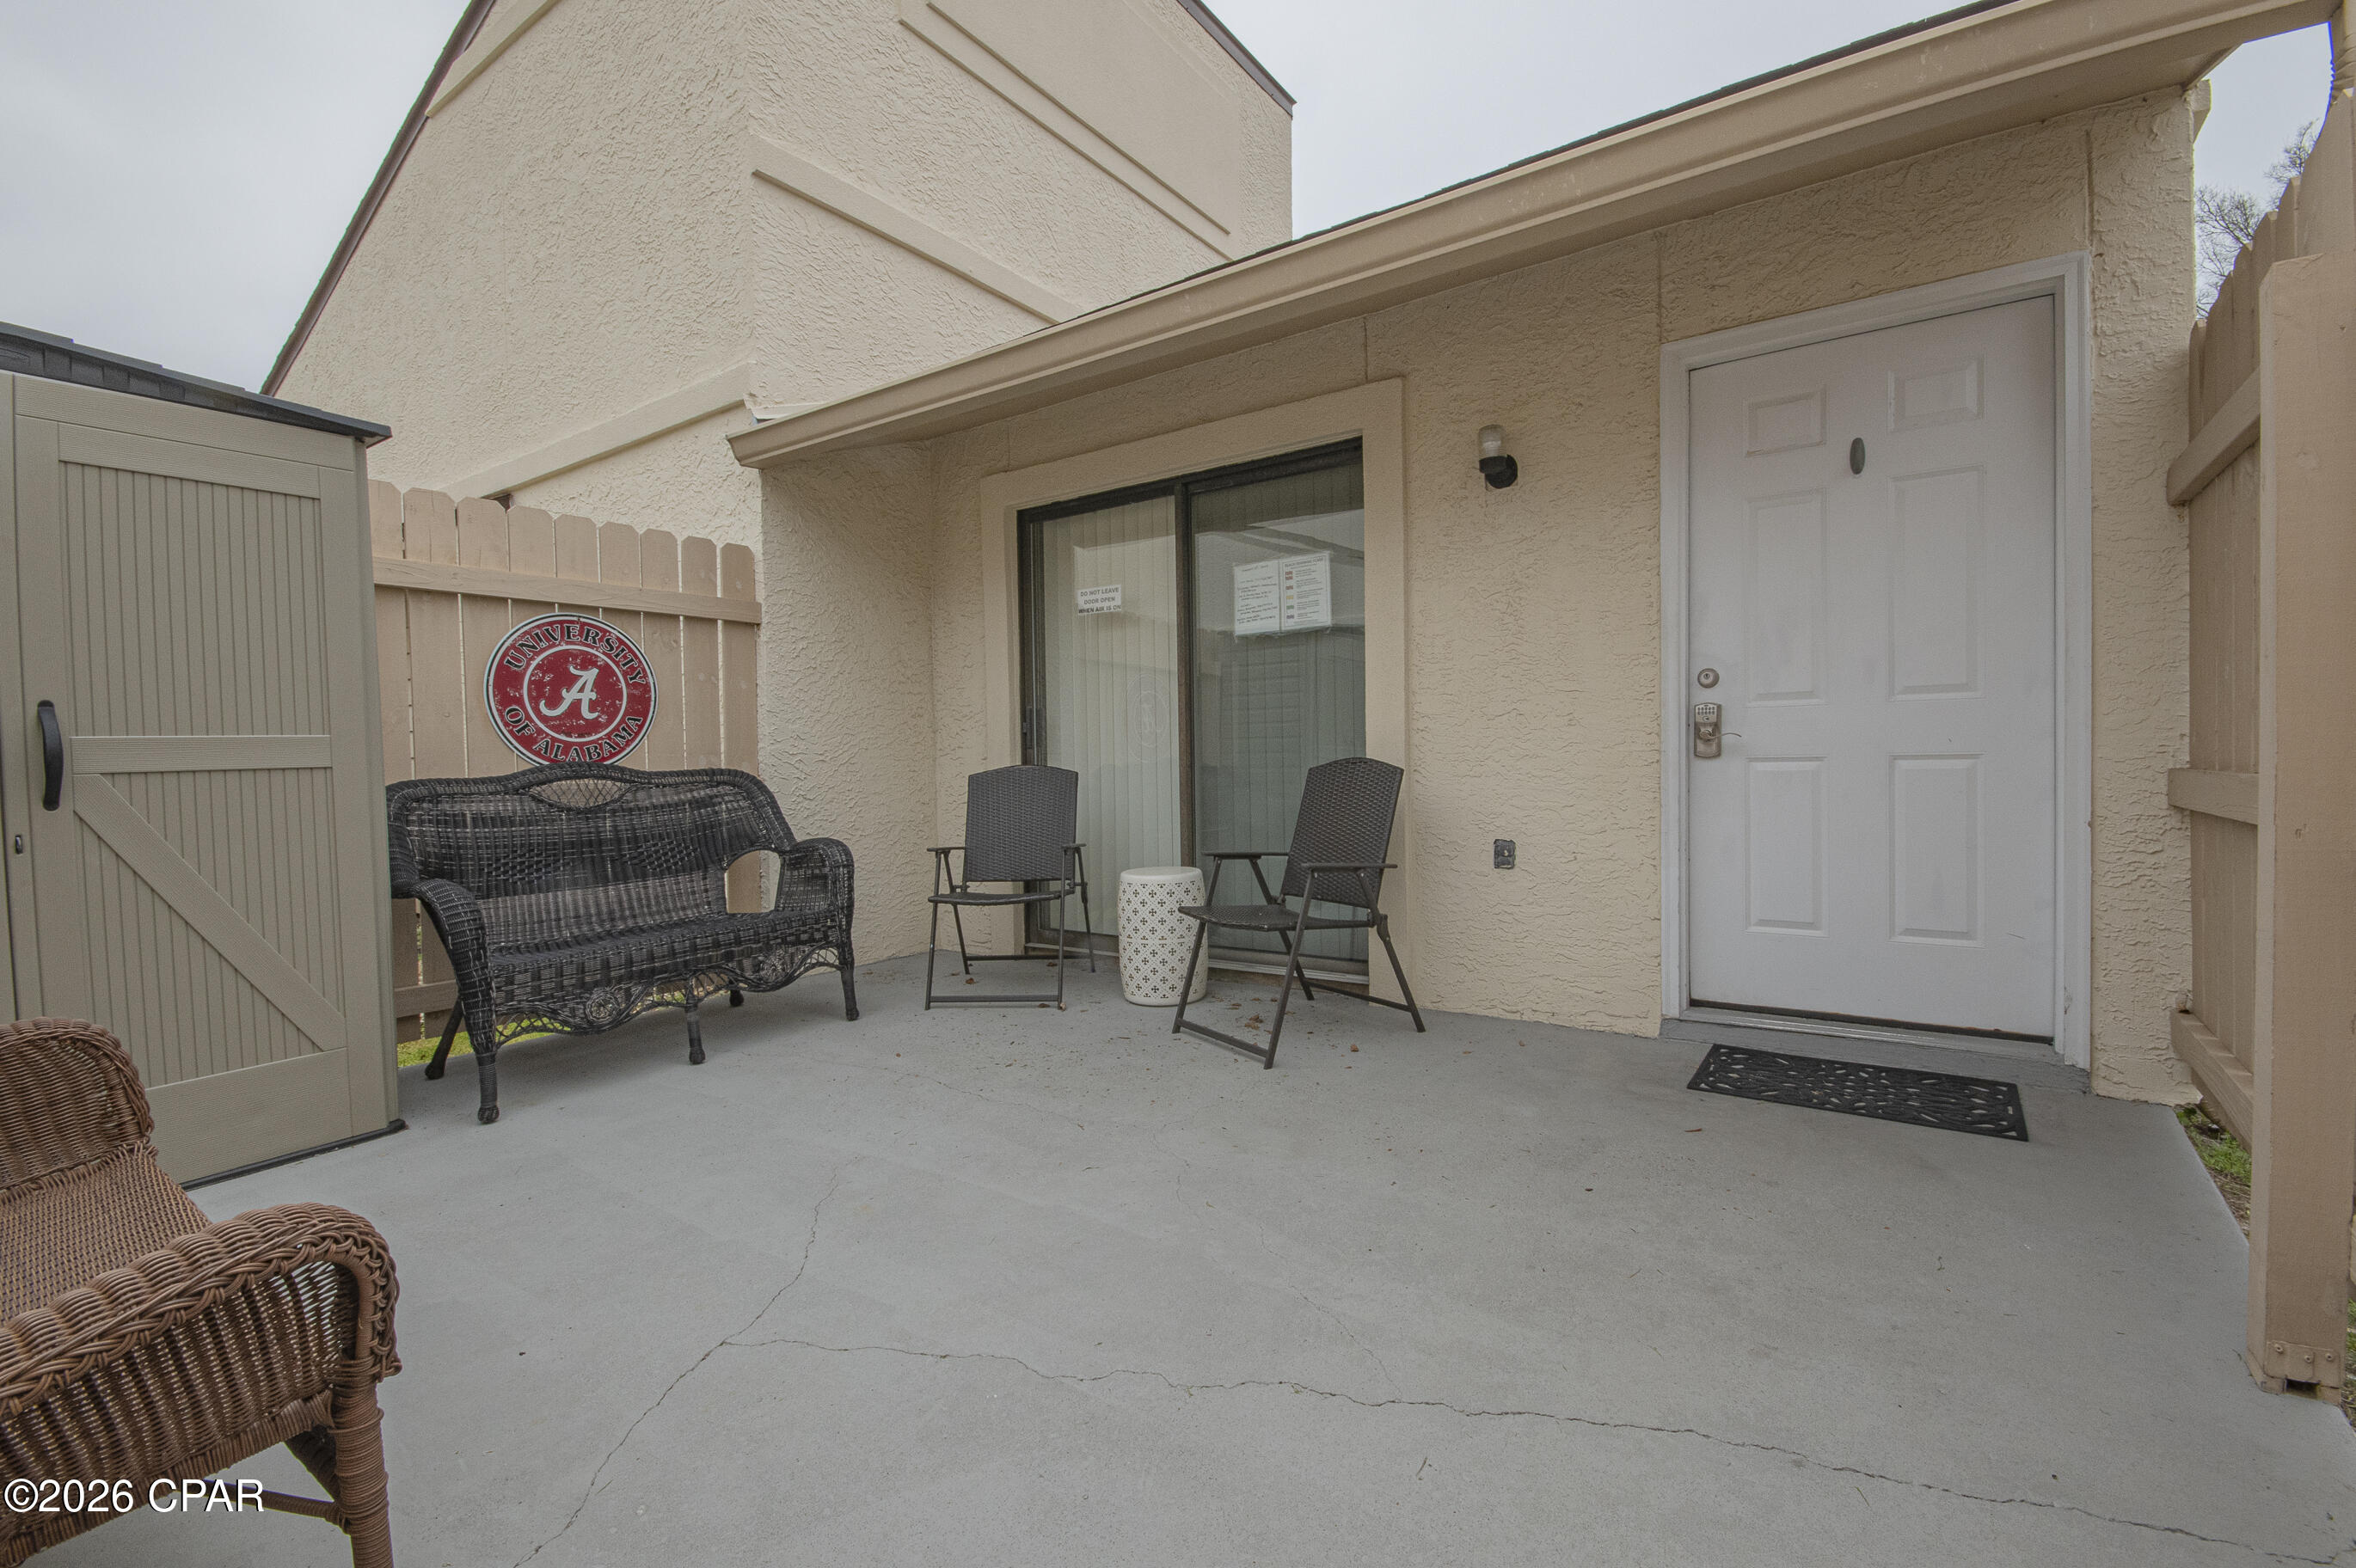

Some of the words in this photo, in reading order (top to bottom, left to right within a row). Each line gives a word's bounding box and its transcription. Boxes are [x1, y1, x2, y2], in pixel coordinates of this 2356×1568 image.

[505, 624, 646, 684] UNIVERSITY
[539, 665, 599, 720] A
[506, 706, 536, 737] OF
[533, 715, 643, 763] ALABAMA
